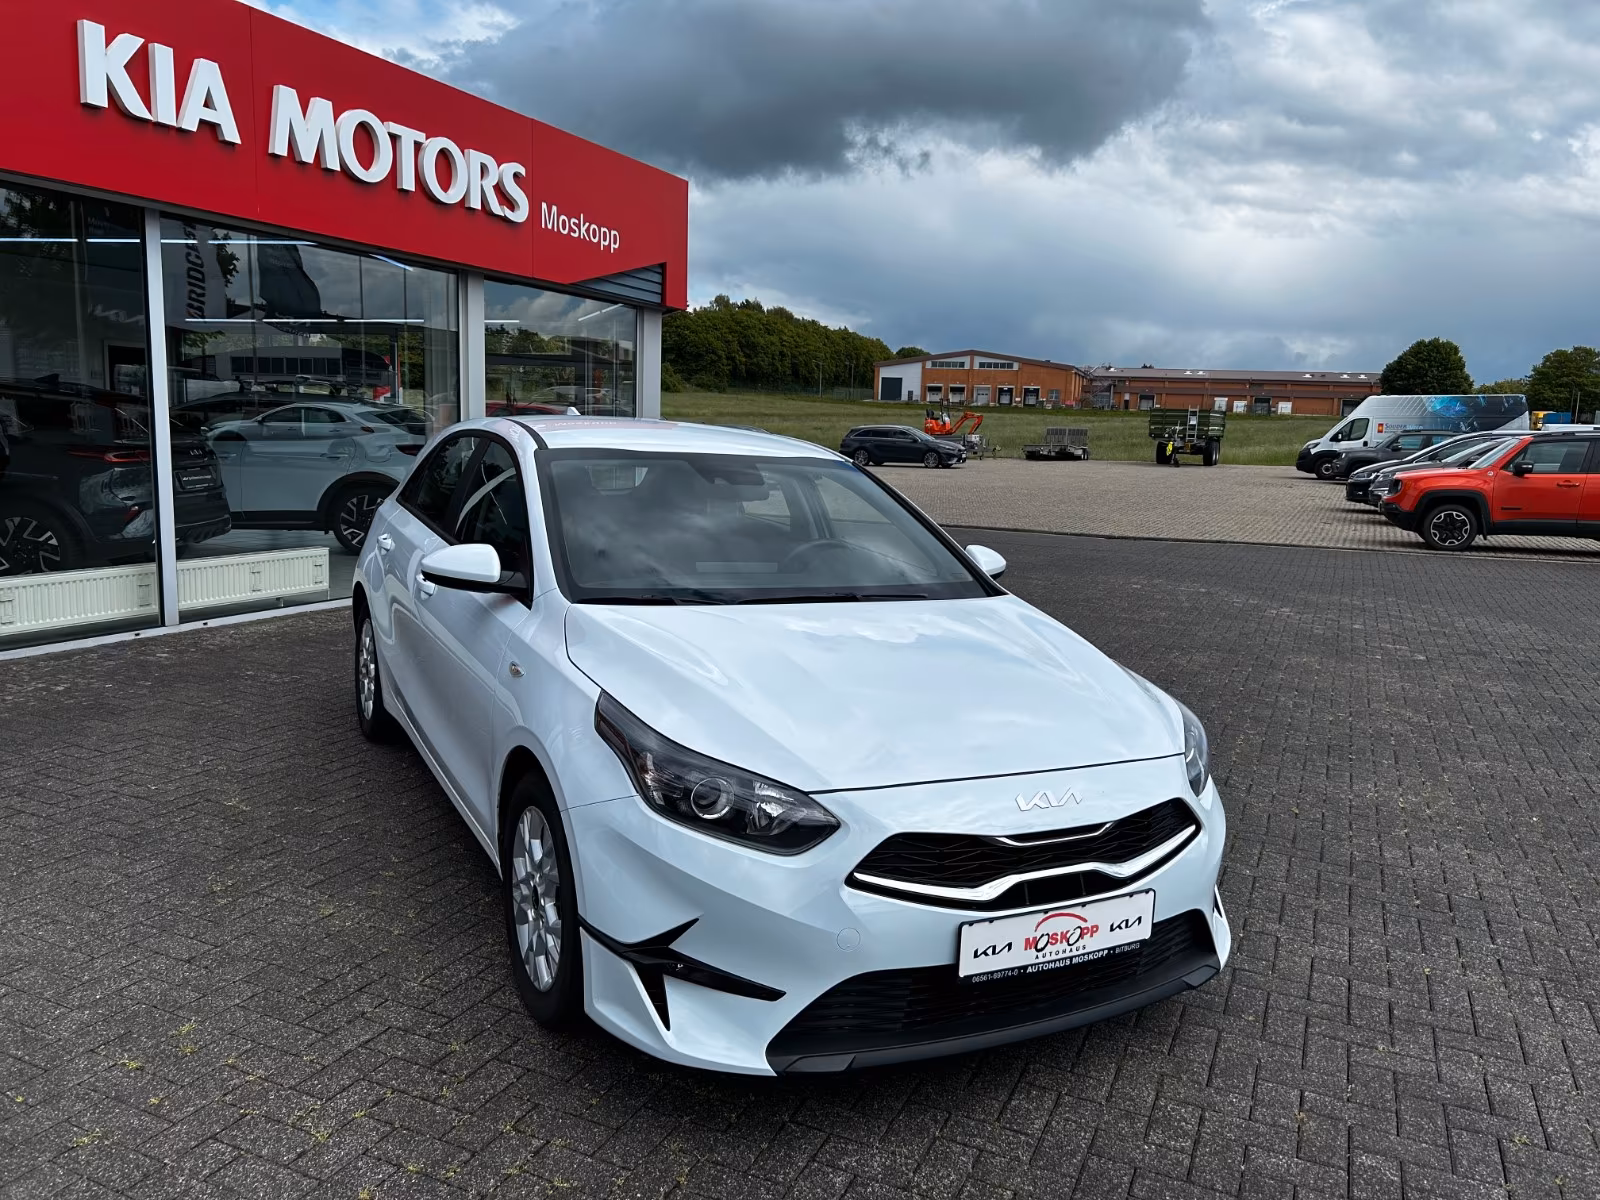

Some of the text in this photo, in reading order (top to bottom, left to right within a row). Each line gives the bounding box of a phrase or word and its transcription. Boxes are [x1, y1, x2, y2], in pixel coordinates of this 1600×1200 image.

[77, 19, 530, 223] KIA MOTORS
[540, 201, 621, 253] Moskopp
[1023, 925, 1100, 953] MOSKOPP
[1034, 944, 1087, 960] AUTOHAUS
[1026, 958, 1071, 974] AUTOHAUS
[1071, 949, 1109, 965] MOSKOPP
[1115, 941, 1140, 955] BITBURG
